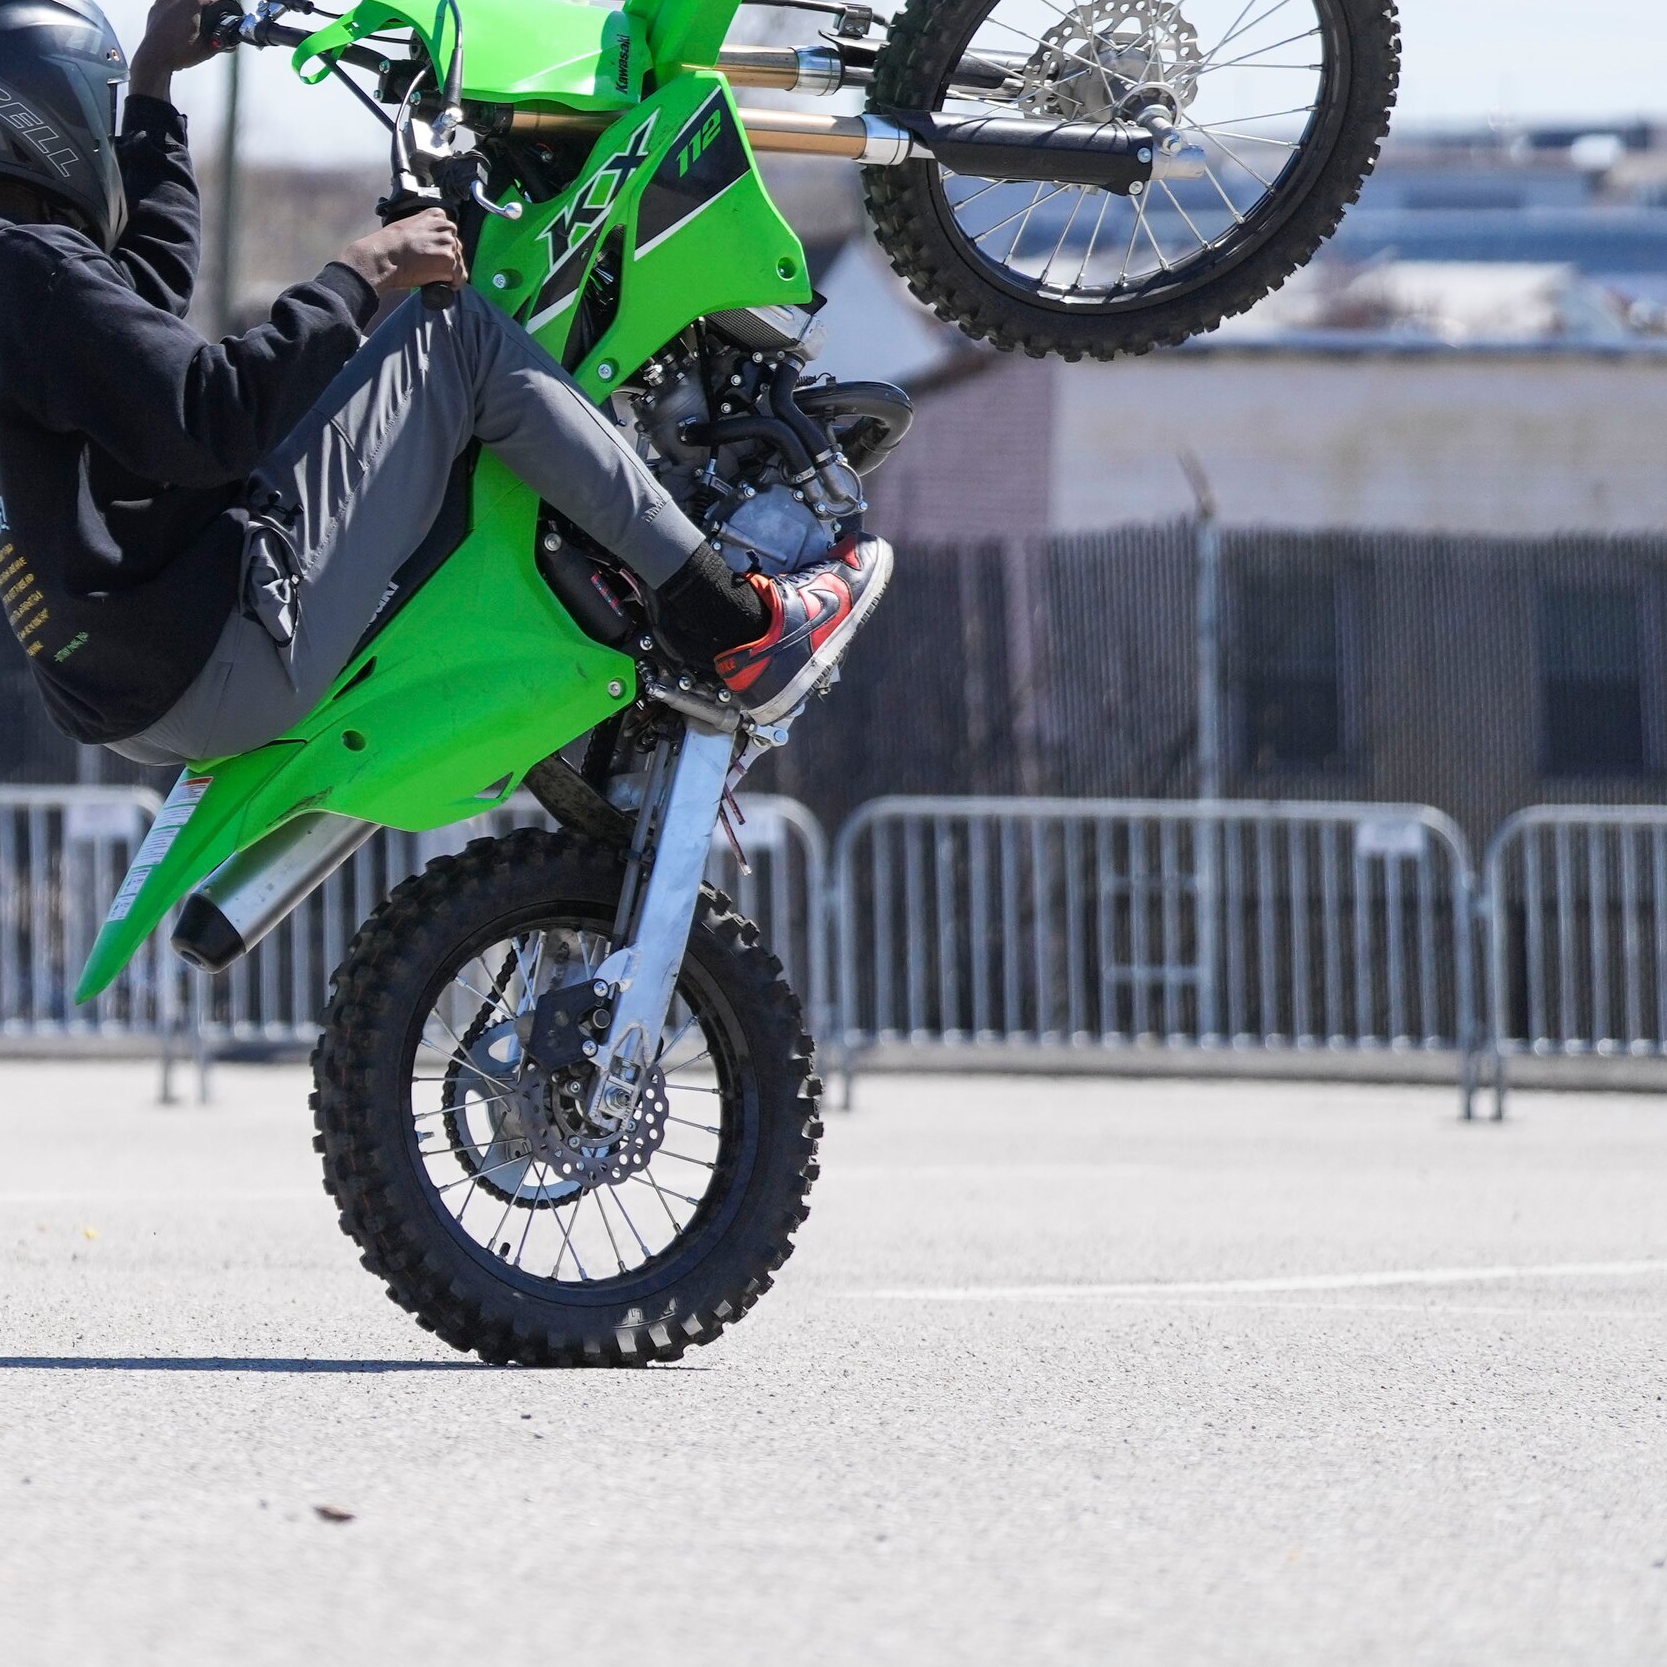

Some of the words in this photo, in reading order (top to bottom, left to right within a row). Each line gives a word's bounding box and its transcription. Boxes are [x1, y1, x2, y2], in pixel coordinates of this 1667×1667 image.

[615, 34, 631, 94] Kawasaki
[676, 109, 722, 178] 112
[534, 107, 662, 272] KX
